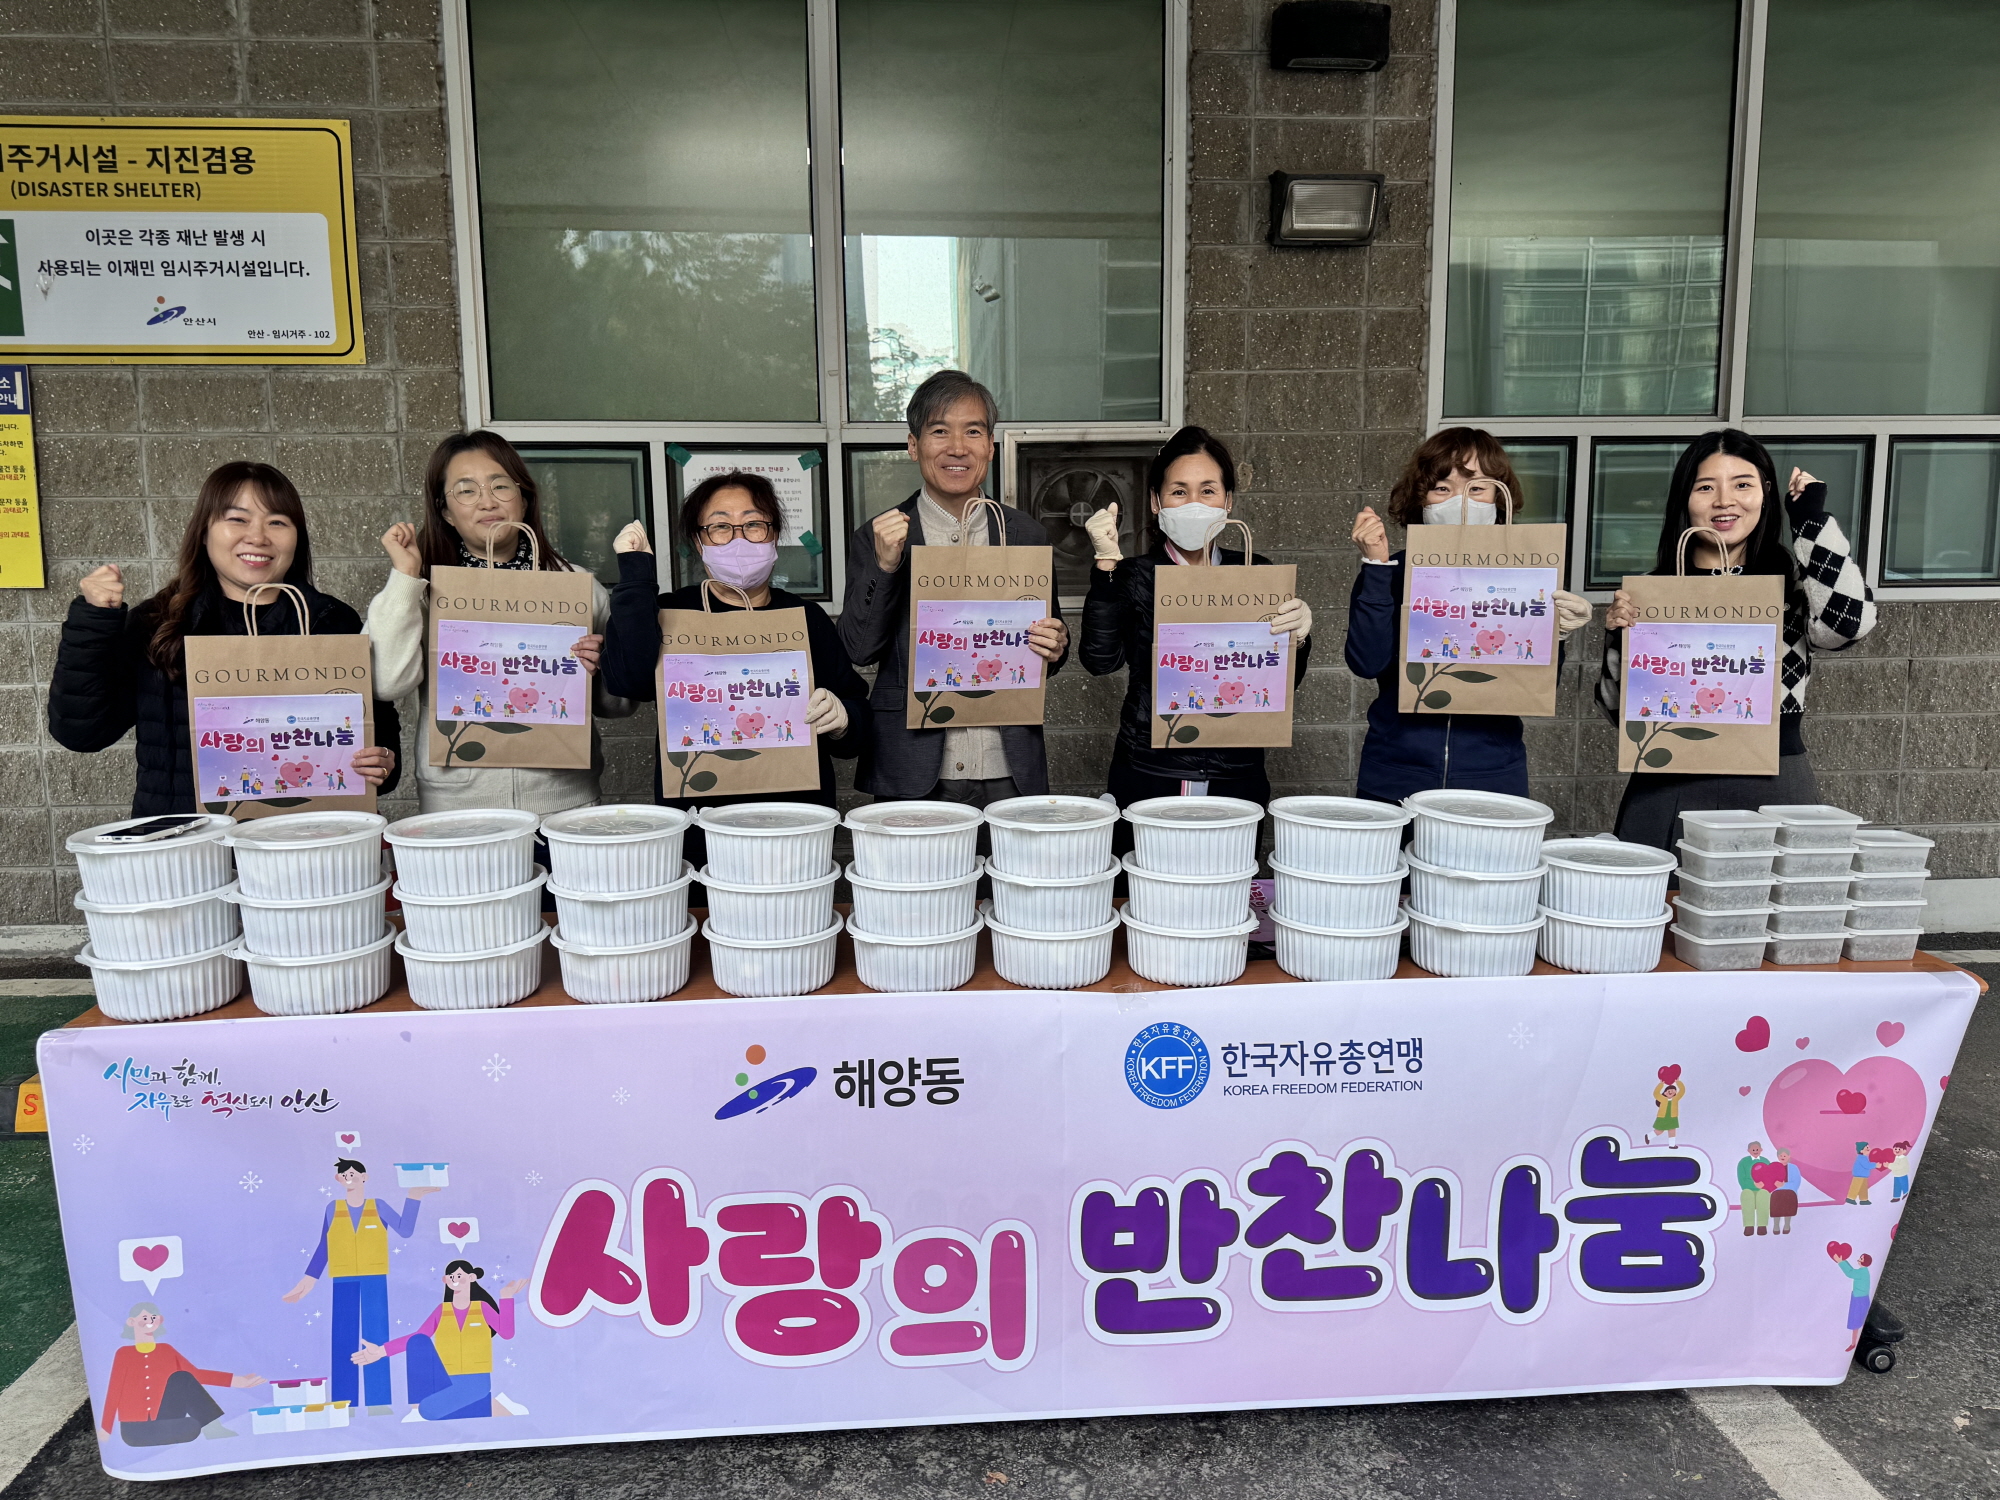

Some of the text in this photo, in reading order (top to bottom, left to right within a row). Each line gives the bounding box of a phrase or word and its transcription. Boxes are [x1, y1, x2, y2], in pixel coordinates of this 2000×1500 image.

[0, 143, 120, 175] 주거시설
[146, 145, 257, 175] 지진겸용
[10, 179, 201, 202] (DISASTER SHELTER)
[85, 228, 267, 247] 이곳은 각종 재난 발생 시
[37, 259, 311, 278] 사용되는 이재민 임시주거시설입니다.
[182, 317, 217, 327] 안산시
[247, 329, 265, 340] 안산
[314, 329, 331, 340] 102
[1411, 552, 1560, 566] GOURMONDO
[917, 574, 1049, 588] GOURMONDO
[436, 596, 588, 615] GOURMONDO
[1160, 593, 1293, 607] GOURMONDO
[1412, 596, 1548, 620] 사랑의 반찬나눔
[662, 630, 805, 647] GOURMONDO
[918, 629, 968, 651] 사랑의
[440, 651, 579, 676] 사랑의 반찬나눔
[1159, 650, 1281, 673] 사랑의 반찬나눔
[1630, 653, 1767, 677] 사랑의 반찬나눔
[194, 665, 367, 685] GOURMONDO
[667, 677, 802, 704] 사랑의 반찬나눔
[199, 727, 356, 754] 사랑의 반찬나눔
[1131, 1022, 1201, 1049] 한국자유총연맹
[1140, 1055, 1195, 1080] KFF
[1220, 1037, 1424, 1078] 한국자유총연맹
[103, 1055, 172, 1094] 시민과
[832, 1056, 966, 1109] 해양동
[1127, 1054, 1208, 1108] KOREA FREEDOM FEDERATION
[1222, 1080, 1424, 1096] KOREA FREEDOM FEDERATION
[126, 1088, 340, 1122] 자유로운 혁신도시 안산
[537, 1133, 1719, 1363] 사랑의 반찬나눔
